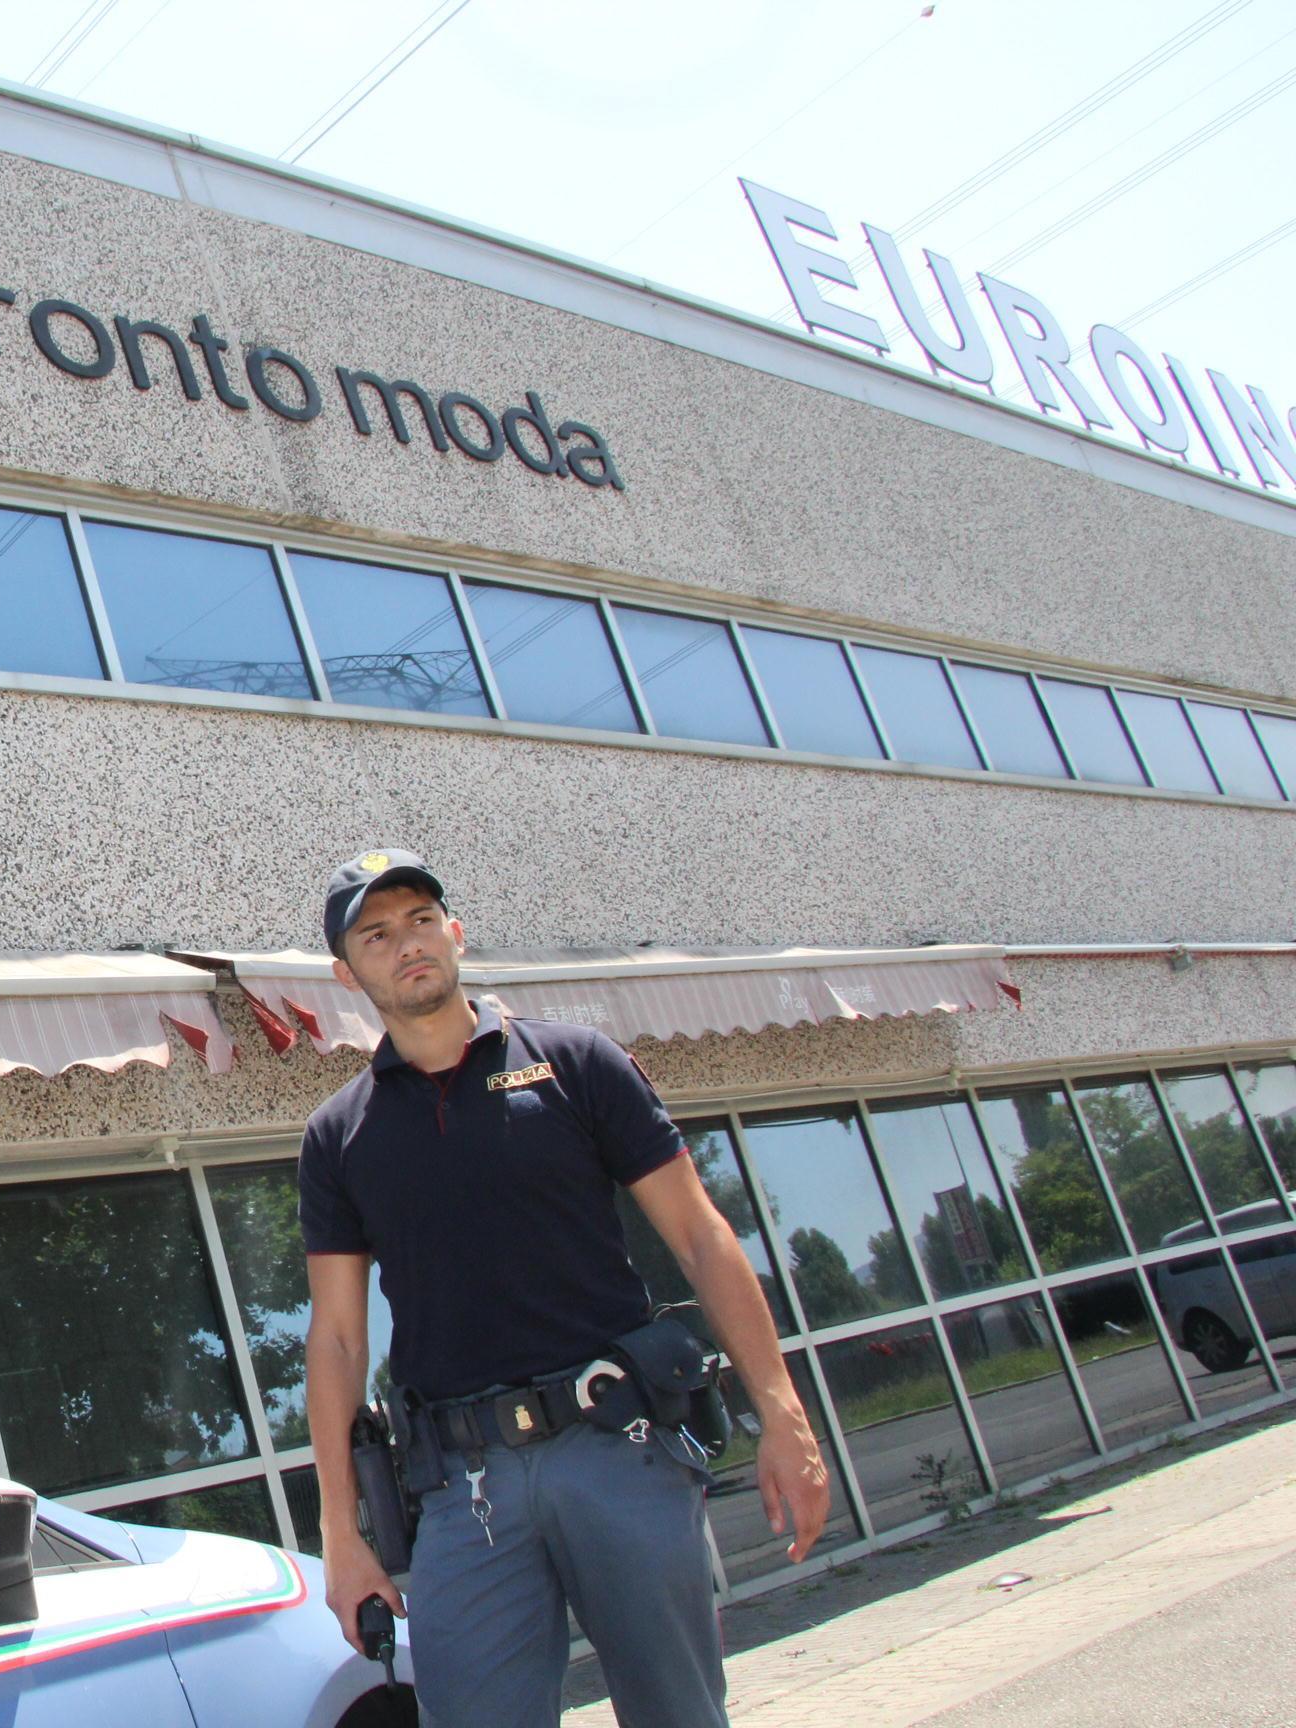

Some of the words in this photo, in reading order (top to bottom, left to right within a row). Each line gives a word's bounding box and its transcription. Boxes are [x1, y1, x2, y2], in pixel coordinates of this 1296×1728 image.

[737, 176, 1296, 490] EUROIN
[337, 365, 625, 492] moda
[490, 1065, 549, 1089] POLIZIA
